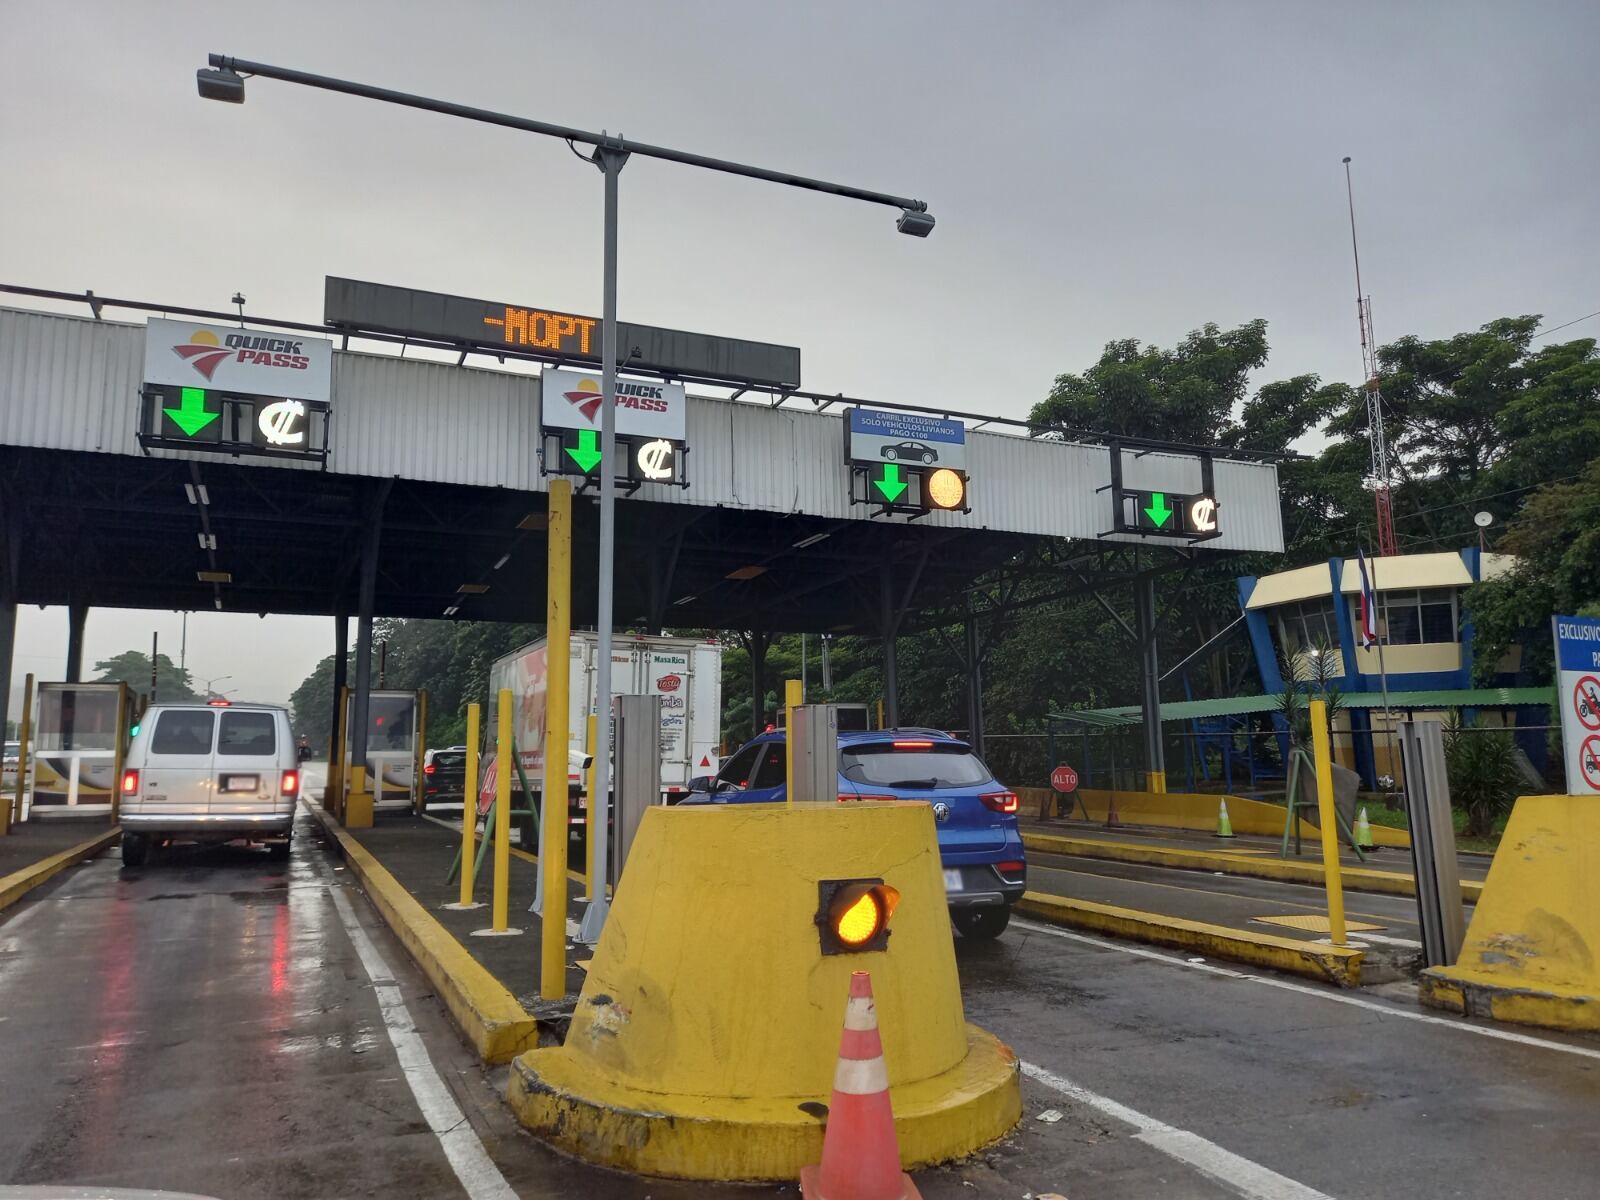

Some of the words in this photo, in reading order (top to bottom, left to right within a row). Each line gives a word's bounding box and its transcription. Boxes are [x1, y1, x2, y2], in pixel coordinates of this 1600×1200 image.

[224, 334, 303, 355] QUICK
[236, 349, 310, 370] PASS
[614, 382, 663, 399] UICK
[614, 395, 668, 412] PASS
[862, 418, 881, 426] SOLO
[922, 426, 955, 436] LIVIANOS
[876, 412, 901, 422] CARRIL
[903, 416, 940, 427] EXCLUSIVO
[890, 429, 910, 437] PAGO
[1054, 774, 1076, 785] ALTO
